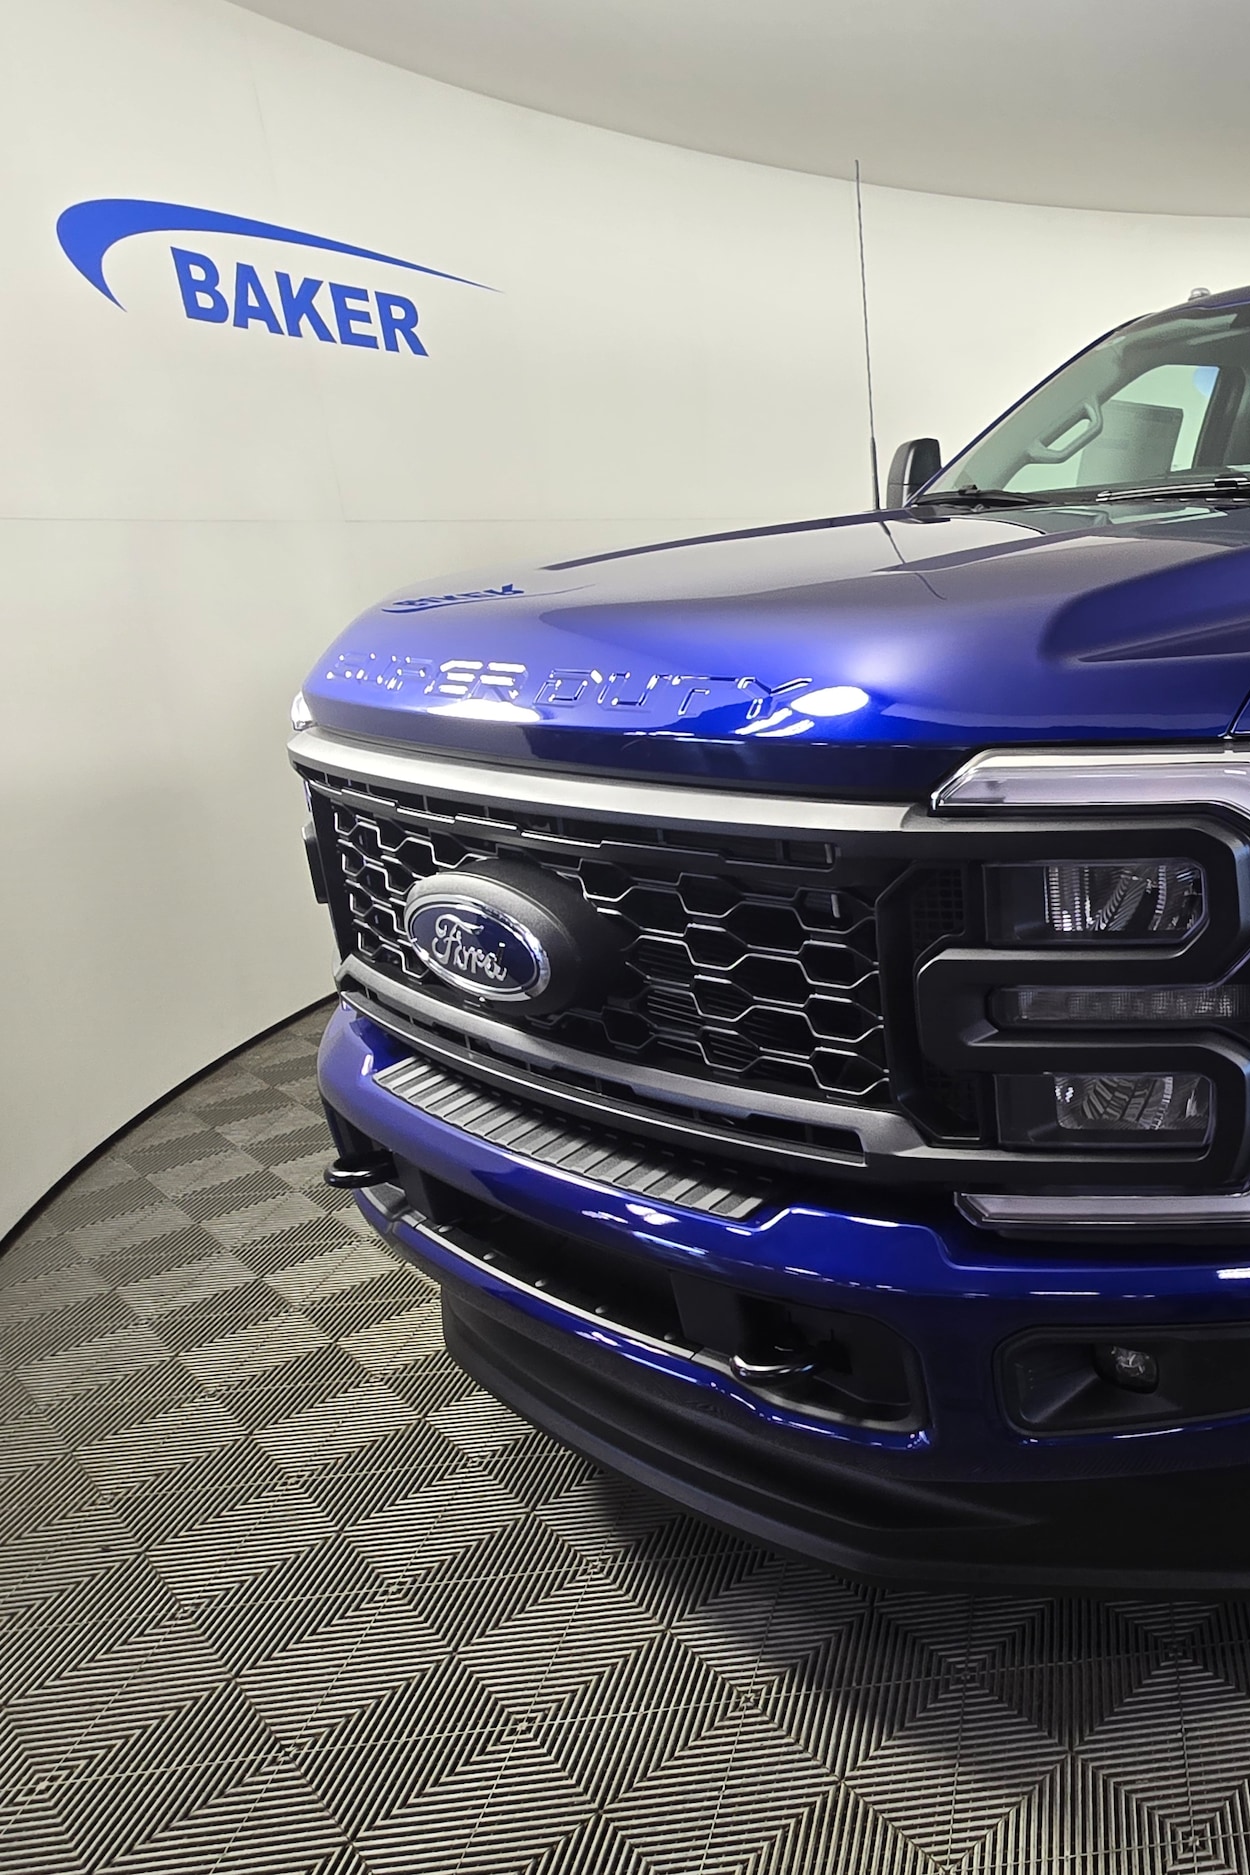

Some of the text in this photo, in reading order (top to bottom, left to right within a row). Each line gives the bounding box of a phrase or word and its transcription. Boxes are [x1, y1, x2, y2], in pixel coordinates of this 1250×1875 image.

[170, 246, 430, 357] BAKER
[325, 652, 812, 720] SUPER DUTY
[431, 913, 508, 982] Ford
